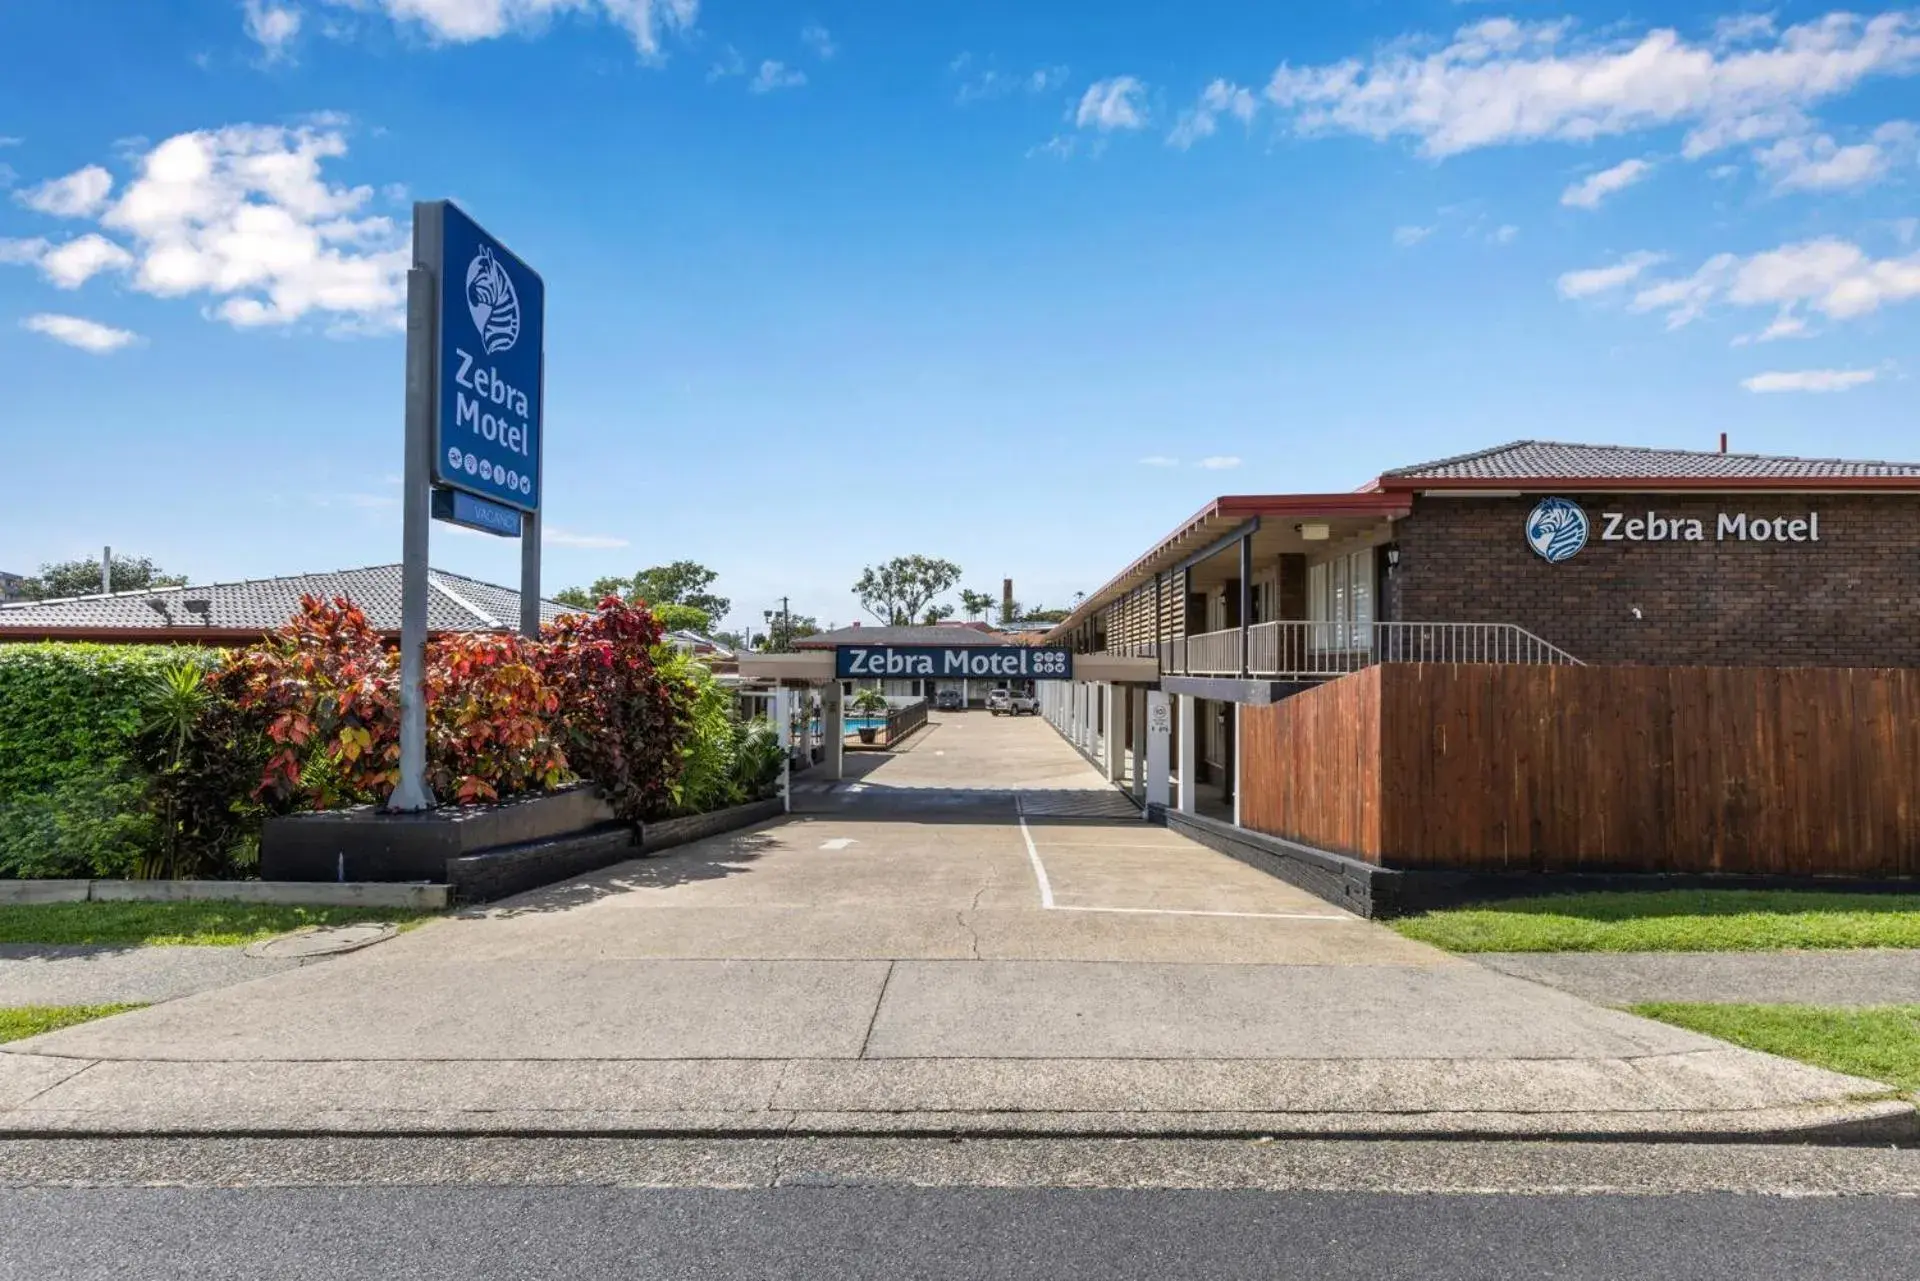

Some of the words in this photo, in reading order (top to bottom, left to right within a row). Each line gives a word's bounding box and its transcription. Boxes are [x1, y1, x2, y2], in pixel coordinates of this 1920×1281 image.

[455, 347, 528, 419] Zebra
[456, 391, 528, 456] Motel
[1602, 512, 1704, 541] Zebra
[1717, 512, 1819, 541] Motel
[849, 648, 934, 674] Zebra
[944, 649, 1027, 674] Motel
